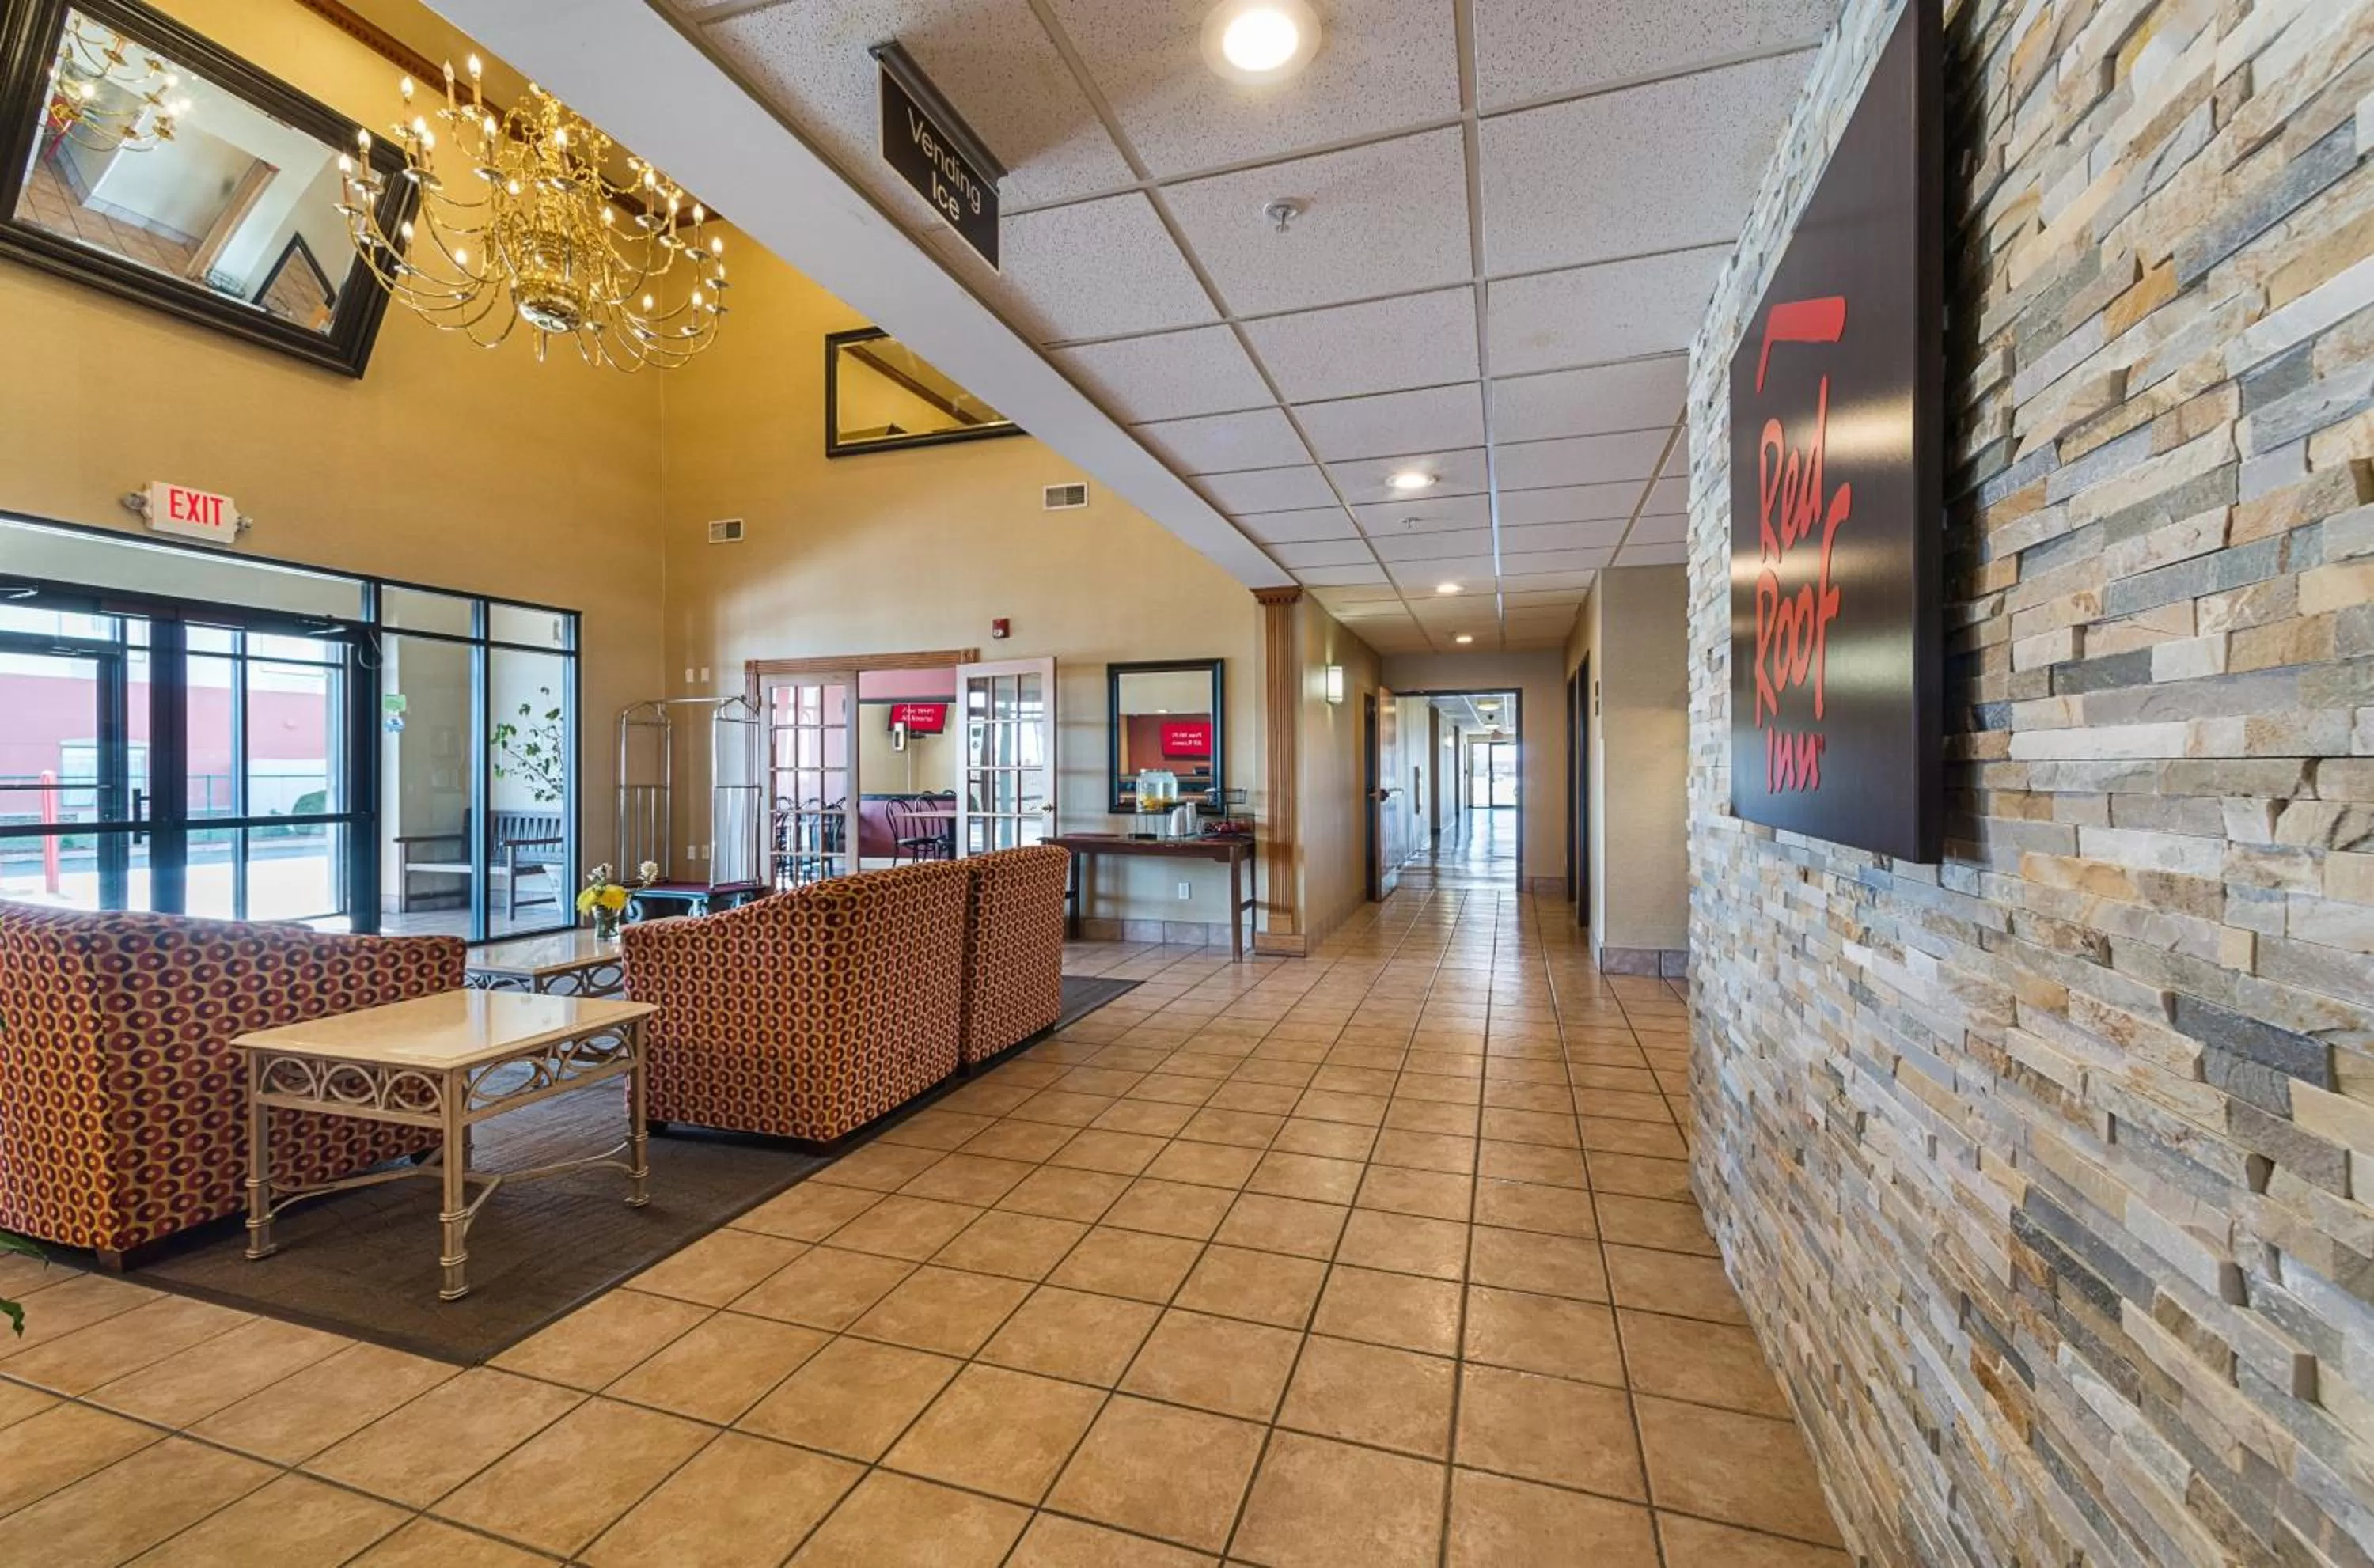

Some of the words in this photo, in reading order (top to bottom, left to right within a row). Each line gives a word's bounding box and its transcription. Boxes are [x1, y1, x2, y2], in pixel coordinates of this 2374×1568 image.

[908, 106, 980, 214] Vending
[931, 171, 960, 221] Ice
[169, 488, 224, 526] EXIT
[1758, 373, 1827, 563] Red
[1755, 481, 1852, 729] Roof
